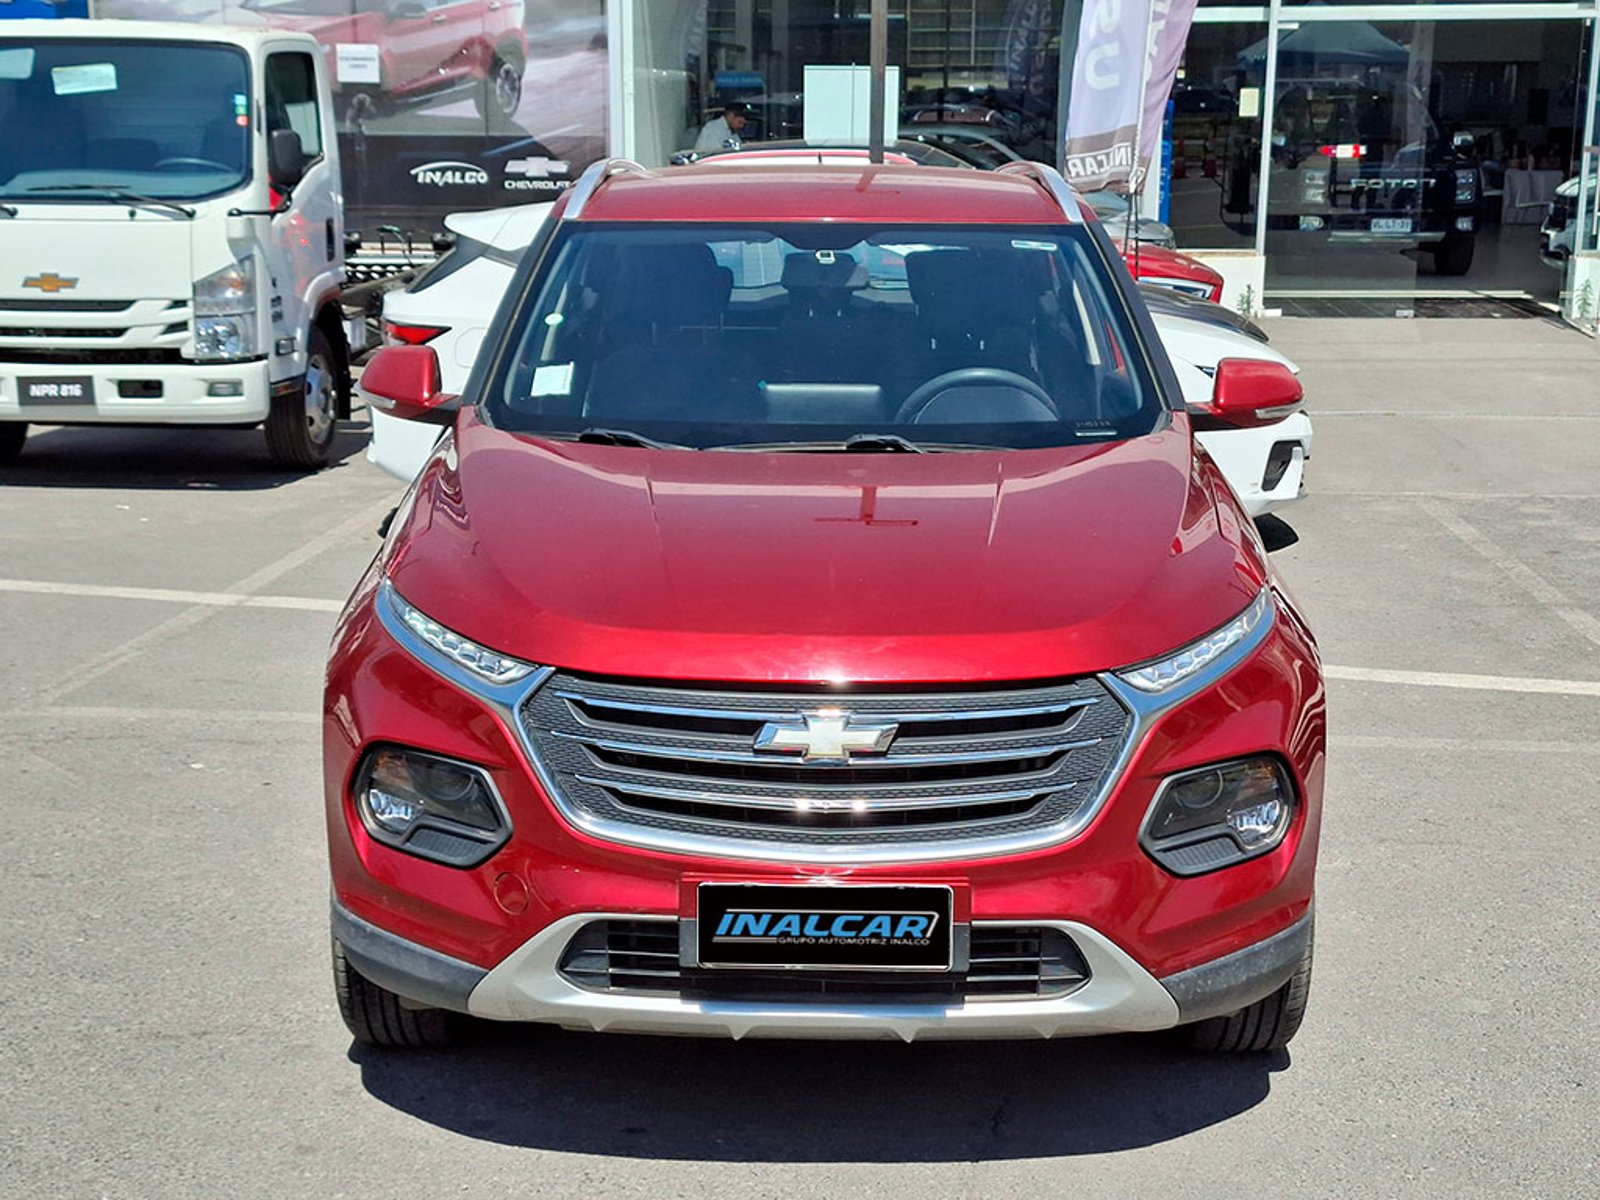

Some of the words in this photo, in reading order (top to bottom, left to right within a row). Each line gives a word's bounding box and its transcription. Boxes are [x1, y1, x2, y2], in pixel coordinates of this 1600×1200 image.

[416, 170, 489, 187] INALCO
[29, 384, 59, 397] NPR
[715, 913, 930, 938] INALCAR
[777, 936, 815, 945] GRUPO
[818, 937, 888, 945] AUTOMOTRIZ
[890, 938, 930, 946] INALCO
